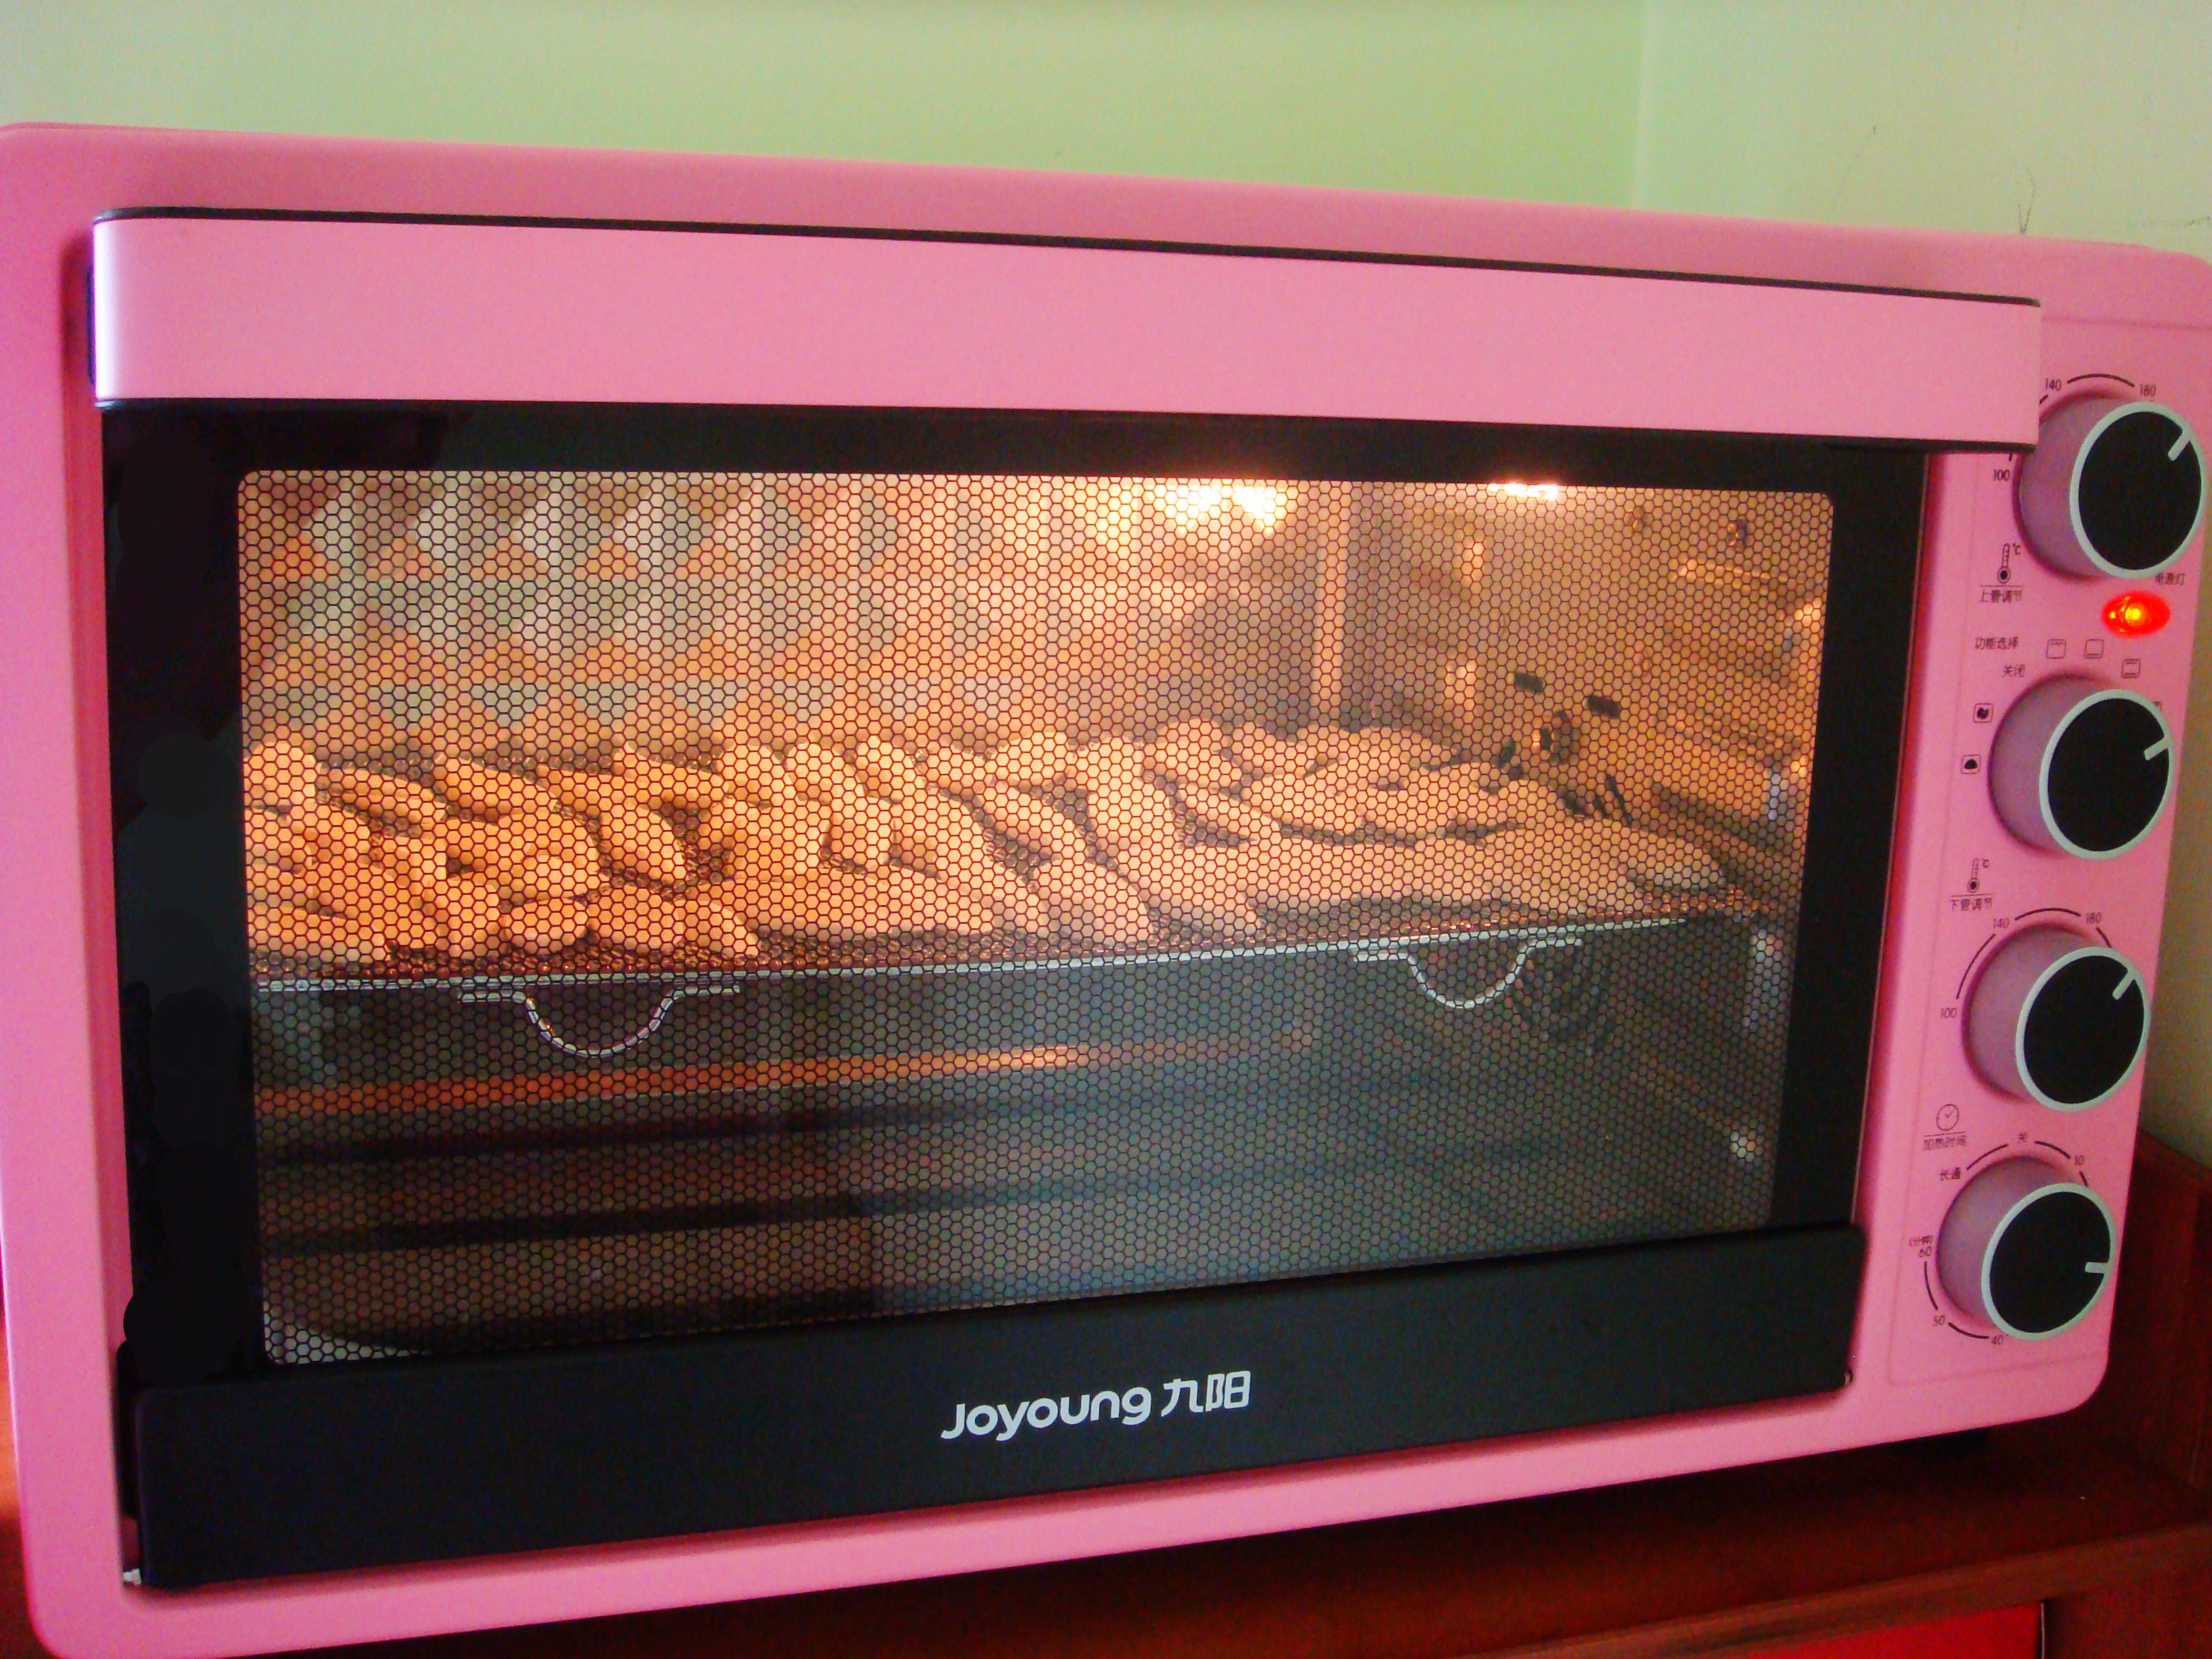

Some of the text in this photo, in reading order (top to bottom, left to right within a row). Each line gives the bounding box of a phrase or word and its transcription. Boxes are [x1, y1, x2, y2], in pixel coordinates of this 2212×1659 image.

[2045, 380, 2062, 391] 140
[2139, 384, 2156, 397] 180
[1993, 469, 2010, 481] 100
[1975, 636, 2019, 651] 功能选择
[2003, 664, 2026, 678] 关闭
[1992, 918, 2010, 929] 140
[2085, 912, 2102, 924] 180
[1940, 1008, 1957, 1019] 100
[1923, 1135, 1967, 1151] 加热时间
[2074, 1155, 2085, 1166] 10
[1932, 1315, 1946, 1327] 50
[1991, 1334, 2005, 1346] 40
[941, 1370, 1252, 1441] Joyoung 九阳
